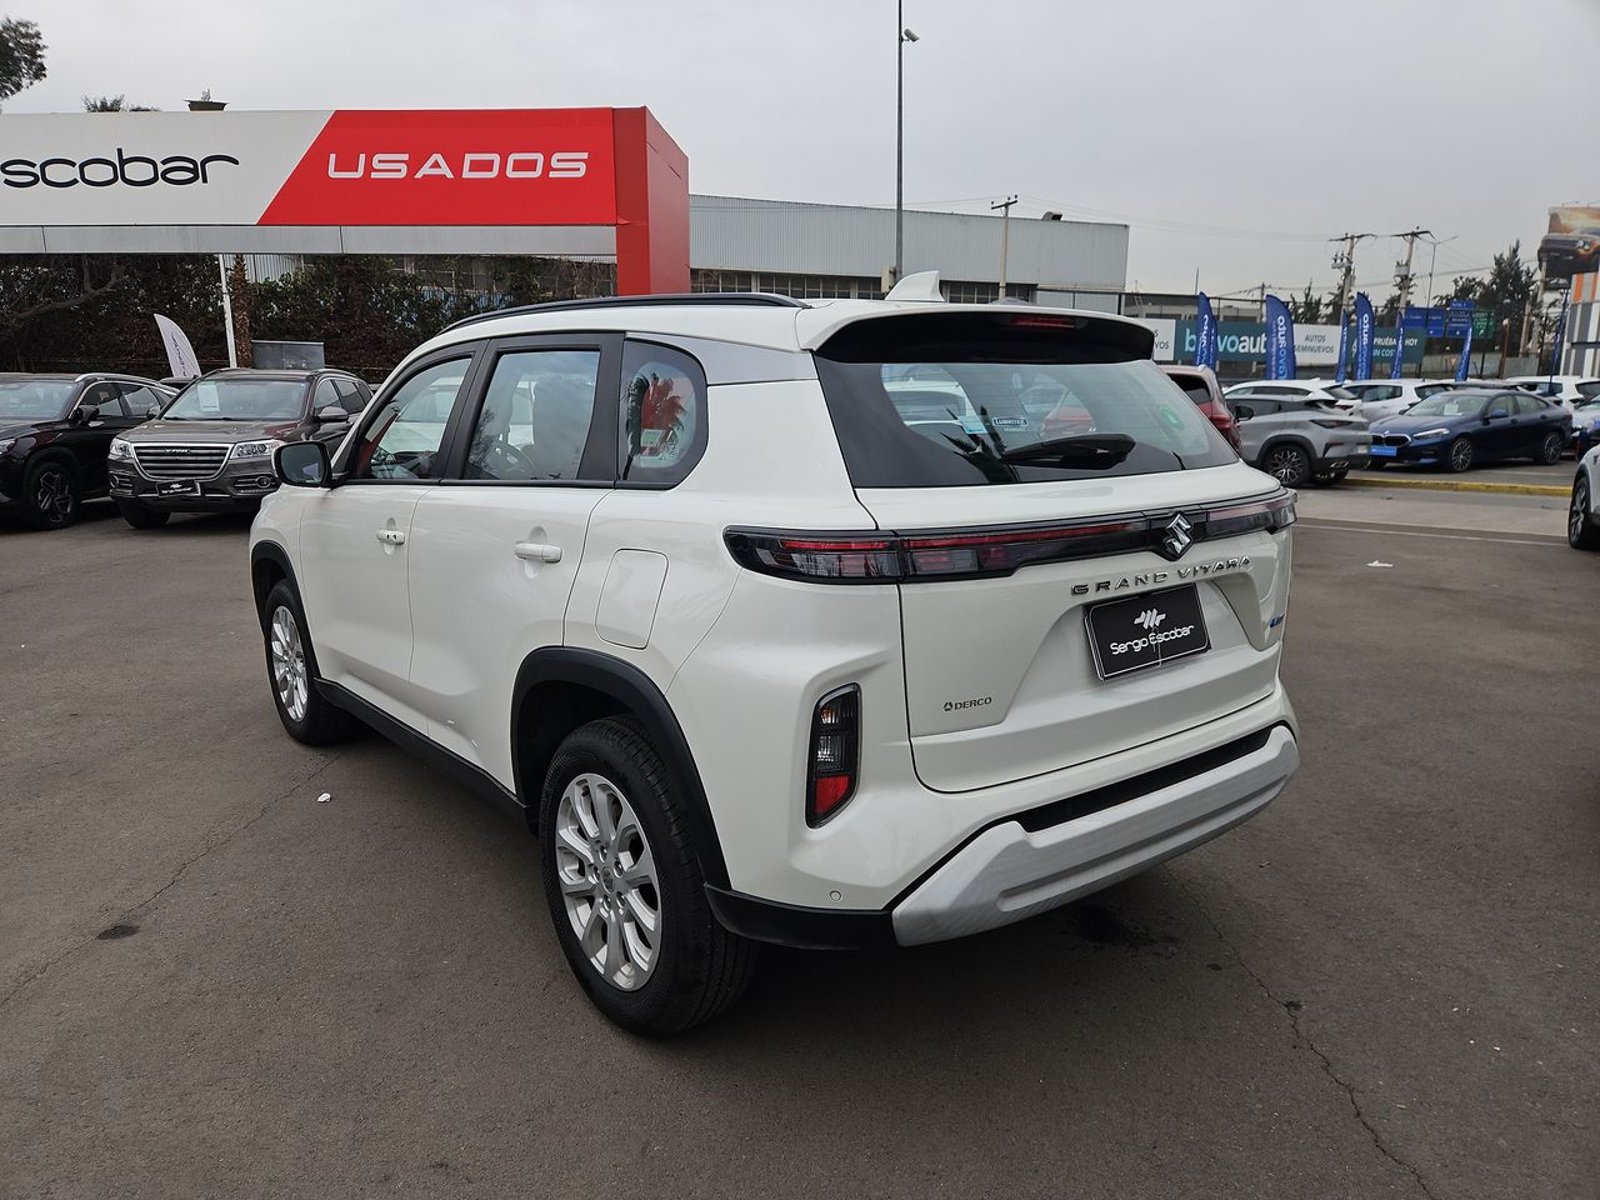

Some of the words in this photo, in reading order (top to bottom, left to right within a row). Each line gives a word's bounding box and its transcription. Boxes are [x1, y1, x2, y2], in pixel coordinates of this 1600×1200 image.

[0, 148, 239, 188] scobar
[327, 152, 589, 179] USADOS
[1185, 328, 1267, 354] bvoaut
[1304, 334, 1326, 343] AUTOS
[1373, 336, 1397, 346] PRUÉBA
[1404, 337, 1418, 346] HOY
[1071, 572, 1169, 596] GRAND
[1177, 555, 1250, 579] VITARA
[1148, 625, 1194, 645] Escobar
[954, 697, 992, 710] DERCO
